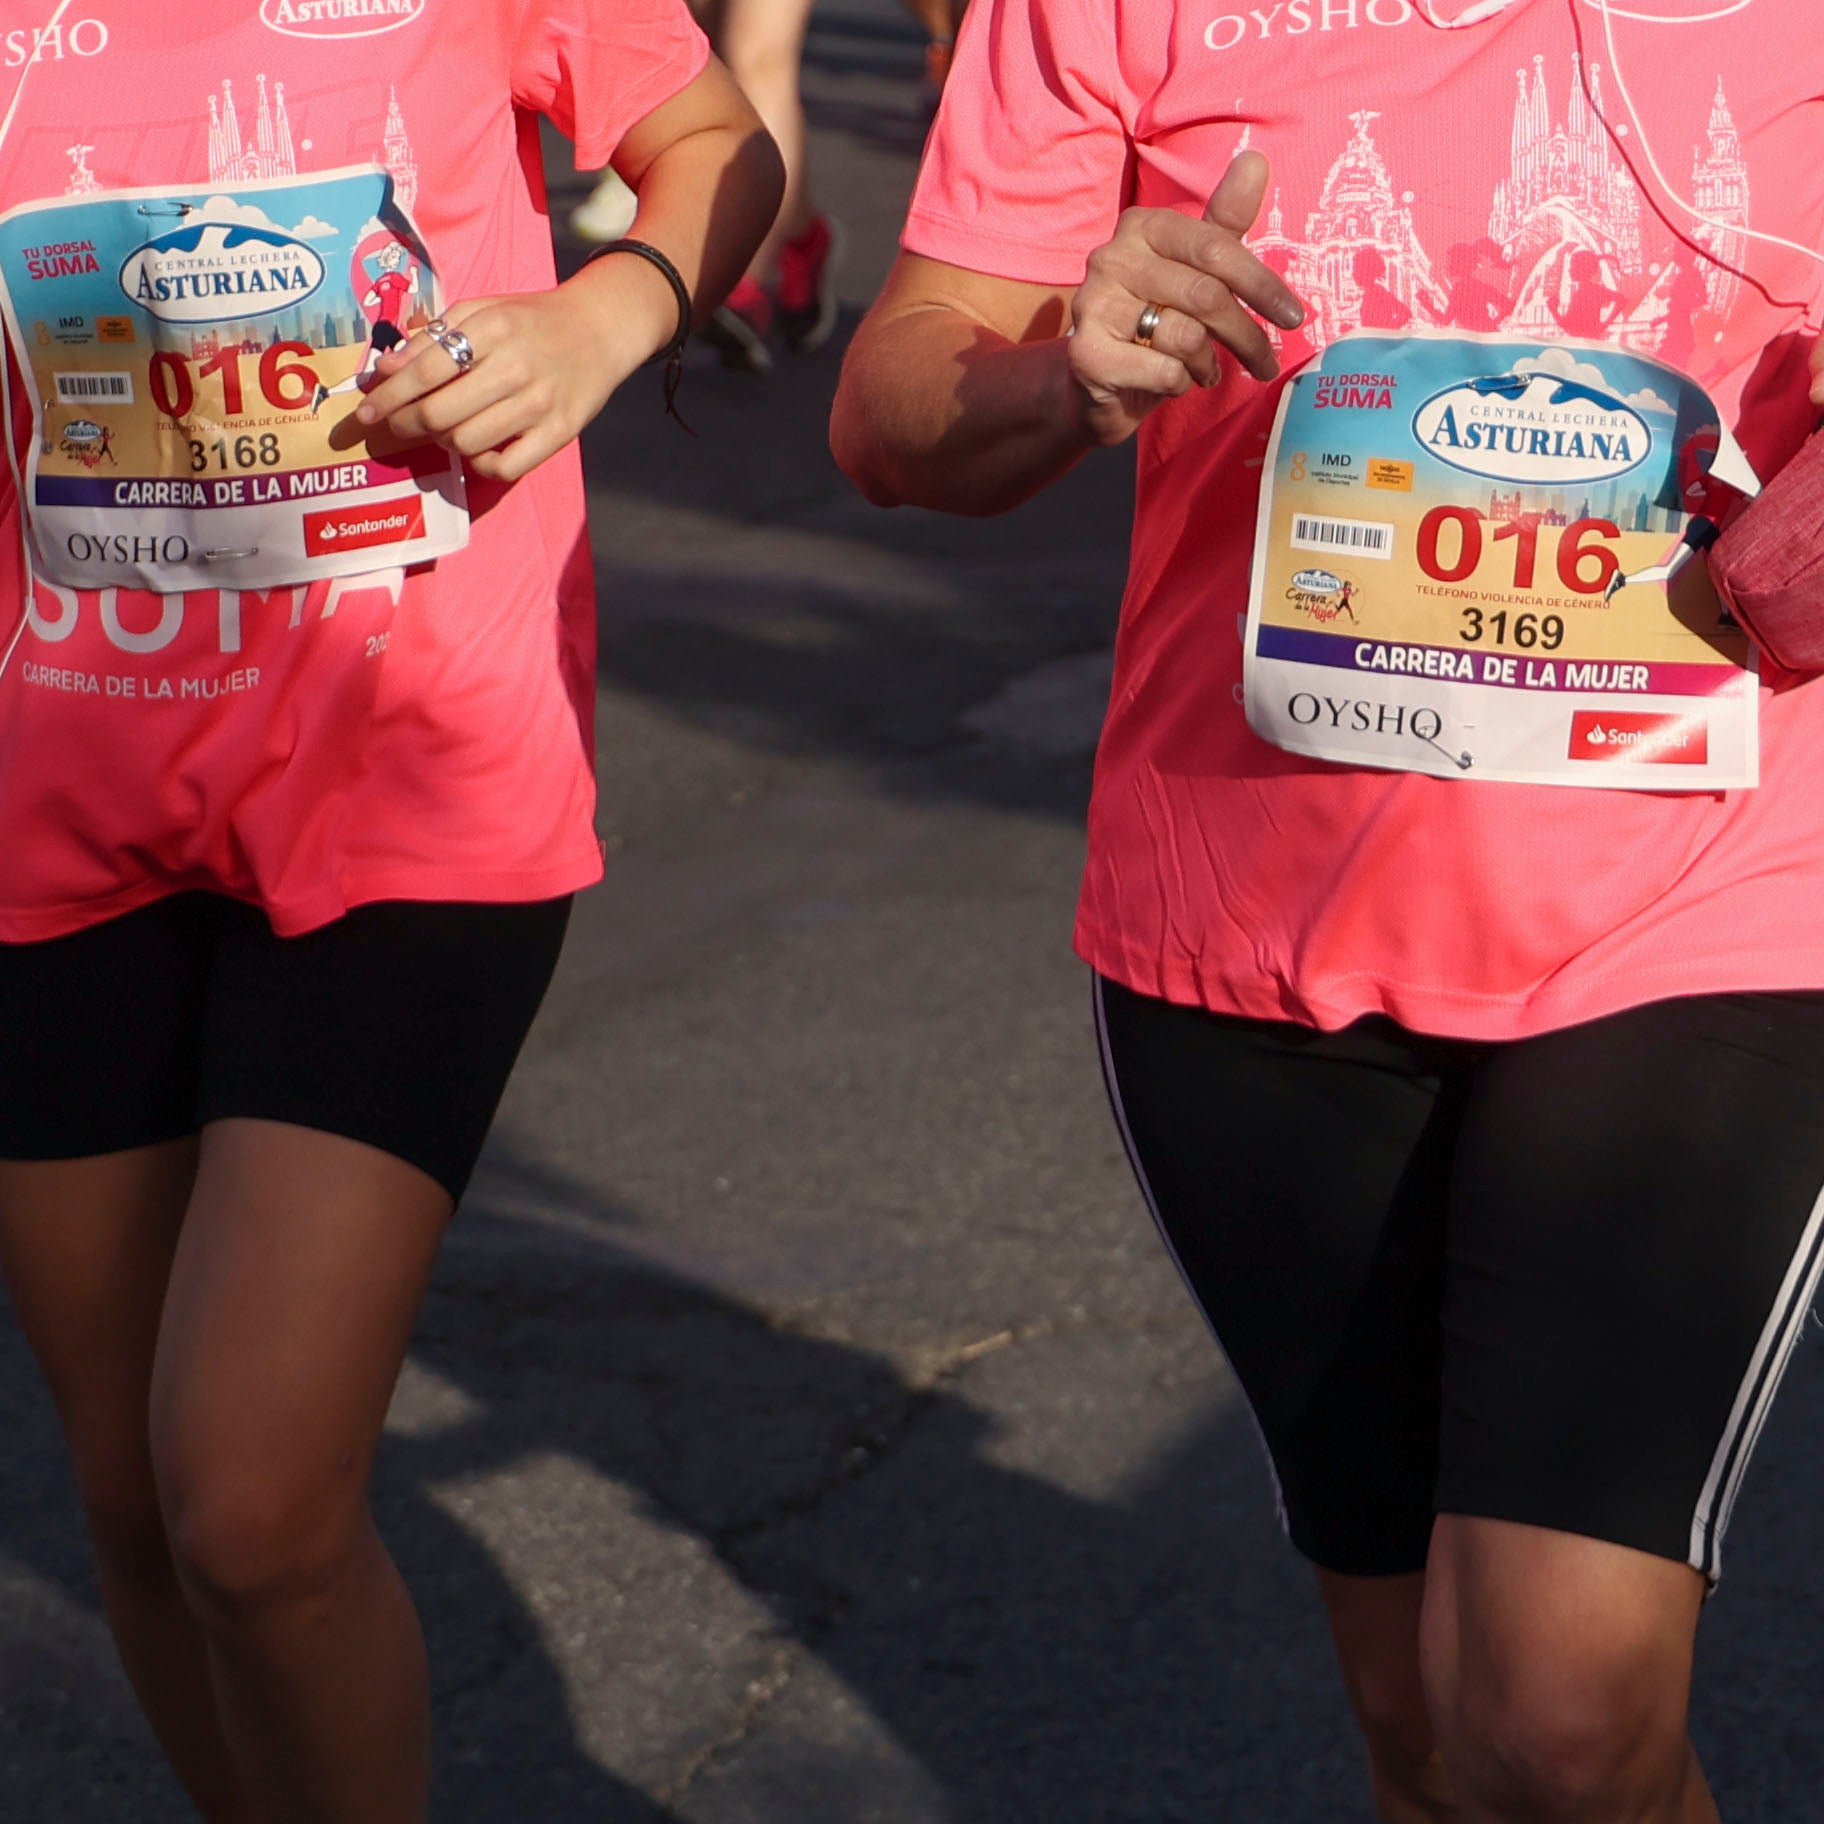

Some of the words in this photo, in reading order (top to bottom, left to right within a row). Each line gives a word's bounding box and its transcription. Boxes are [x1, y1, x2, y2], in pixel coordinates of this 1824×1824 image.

[22, 247, 41, 260] TU
[44, 240, 96, 256] DORSAL
[154, 256, 224, 273] CENTRAL
[230, 251, 300, 266] LECHERA
[27, 253, 100, 281] SUMA
[136, 261, 309, 302] ASTURIANA
[59, 316, 84, 329] IMD
[149, 340, 320, 419] 016
[1318, 375, 1335, 388] TU
[1339, 373, 1398, 388] DORSAL
[1313, 388, 1393, 409] SUMA
[259, 416, 273, 426] DE
[1470, 404, 1545, 423] CENTRAL
[1553, 411, 1629, 428] LECHERA
[1429, 405, 1632, 463] ASTURIANA
[189, 432, 281, 473] 3168
[1322, 453, 1351, 466] IMD
[115, 481, 207, 506] CARRERA
[215, 480, 245, 504] DE
[253, 477, 285, 502] LA
[290, 464, 368, 497] MUJER
[339, 512, 408, 538] Santander
[67, 533, 190, 565] OYSHO
[1416, 504, 1621, 595] 016
[1481, 592, 1543, 607] VIOLENCIA
[1546, 597, 1561, 607] DE
[1459, 607, 1564, 650] 3169
[22, 660, 100, 693] CARRERA
[107, 674, 136, 697] DE
[143, 675, 174, 698] LA
[181, 666, 261, 700] MUJER
[1355, 642, 1474, 679] CARRERA
[1484, 656, 1517, 683] DE
[1525, 661, 1557, 687] LA
[1565, 664, 1649, 690] MUJER
[1287, 692, 1442, 740] OYSHO
